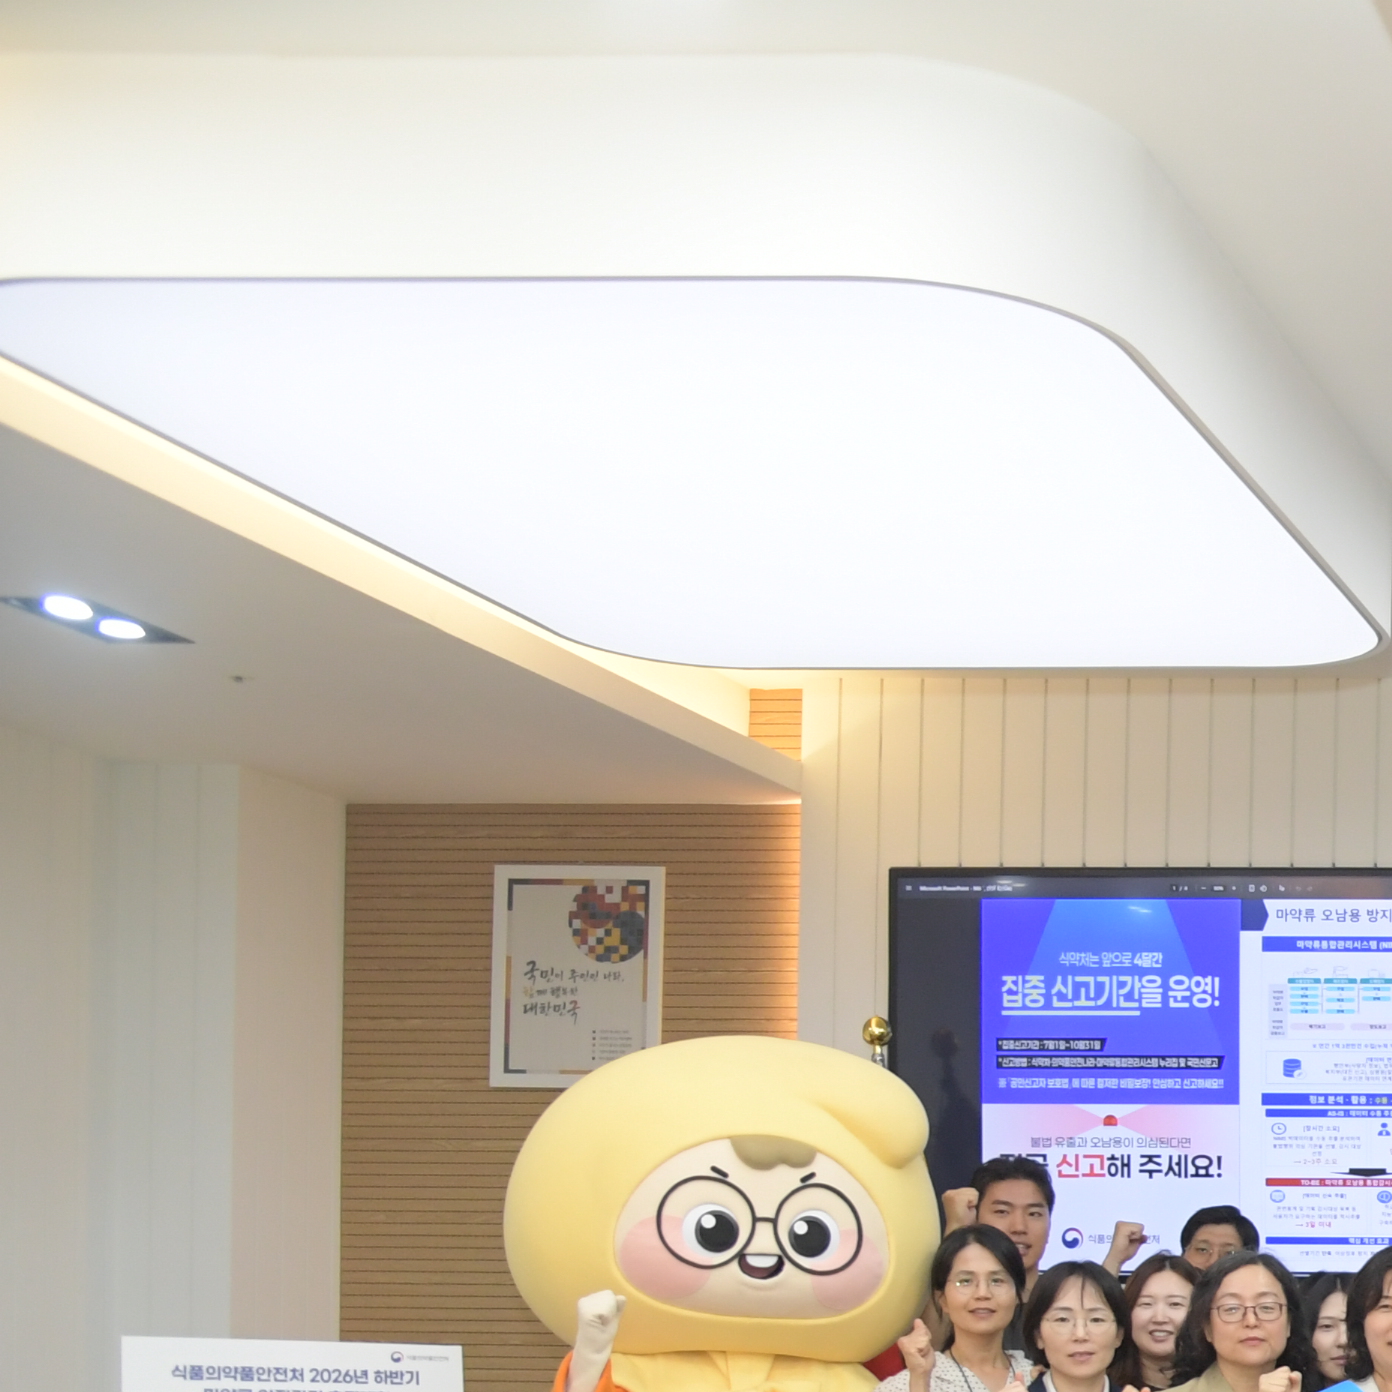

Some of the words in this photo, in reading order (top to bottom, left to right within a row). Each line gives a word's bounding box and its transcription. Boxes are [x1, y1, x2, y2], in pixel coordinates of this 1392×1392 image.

[1276, 908, 1316, 923] 마약류
[1321, 908, 1362, 923] 오남용
[1366, 908, 1392, 923] 방지
[1296, 940, 1378, 951] 마약류통합관리시스템
[1059, 952, 1099, 967] 식약처는
[1102, 952, 1132, 967] 앞으로
[1134, 952, 1163, 968] 4달간
[1001, 975, 1046, 1008] 집중
[1051, 975, 1163, 1008] 신고기간을
[1168, 975, 1220, 1008] 운영!
[523, 1000, 581, 1026] 대한민국
[1309, 1095, 1325, 1104] 정보
[1328, 1095, 1344, 1105] 분석
[1031, 1137, 1052, 1148] 불법
[1055, 1137, 1088, 1149] 유출과
[1090, 1137, 1134, 1149] 오남용이
[1137, 1137, 1192, 1149] 의심된다면
[1056, 1154, 1131, 1179] 신고해
[1139, 1154, 1223, 1179] 주세요!
[171, 1364, 304, 1383] 식품의약품안전처
[309, 1368, 369, 1385] 2026년
[373, 1369, 420, 1386] 하반기
